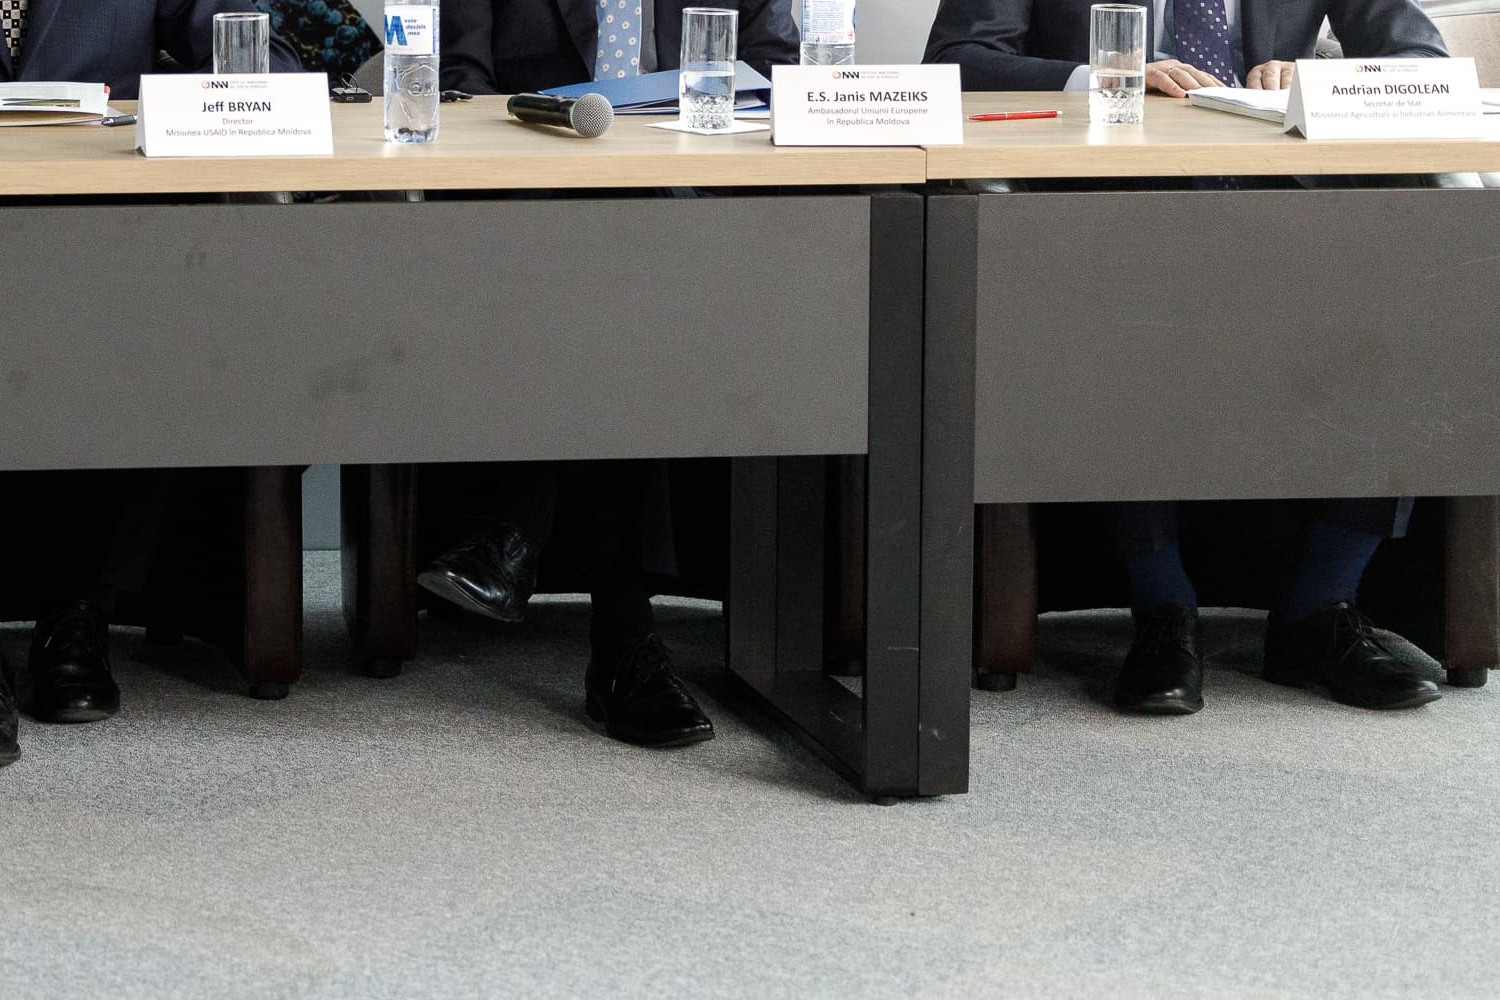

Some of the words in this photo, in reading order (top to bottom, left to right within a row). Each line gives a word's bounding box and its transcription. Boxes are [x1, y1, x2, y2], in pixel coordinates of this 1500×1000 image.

[1331, 85, 1381, 96] Andrian
[1384, 84, 1450, 95] DIGOLEAN
[807, 91, 830, 102] E.S.
[834, 91, 865, 102] Janis
[869, 91, 928, 102] MAZEIKS
[202, 101, 225, 113] Jeff
[228, 101, 271, 112] BRYAN
[1363, 100, 1394, 108] Secretar
[1407, 99, 1422, 107] Stat
[808, 107, 860, 115] Ambasadorul
[861, 107, 889, 115] Uniunii
[891, 107, 928, 116] Europene
[222, 117, 253, 125] Director
[836, 118, 874, 127] Republica
[876, 118, 910, 126] Moldova
[166, 129, 201, 137] Misiunea
[203, 128, 227, 136] USAID
[238, 128, 276, 138] Republica
[277, 128, 311, 136] Moldova
